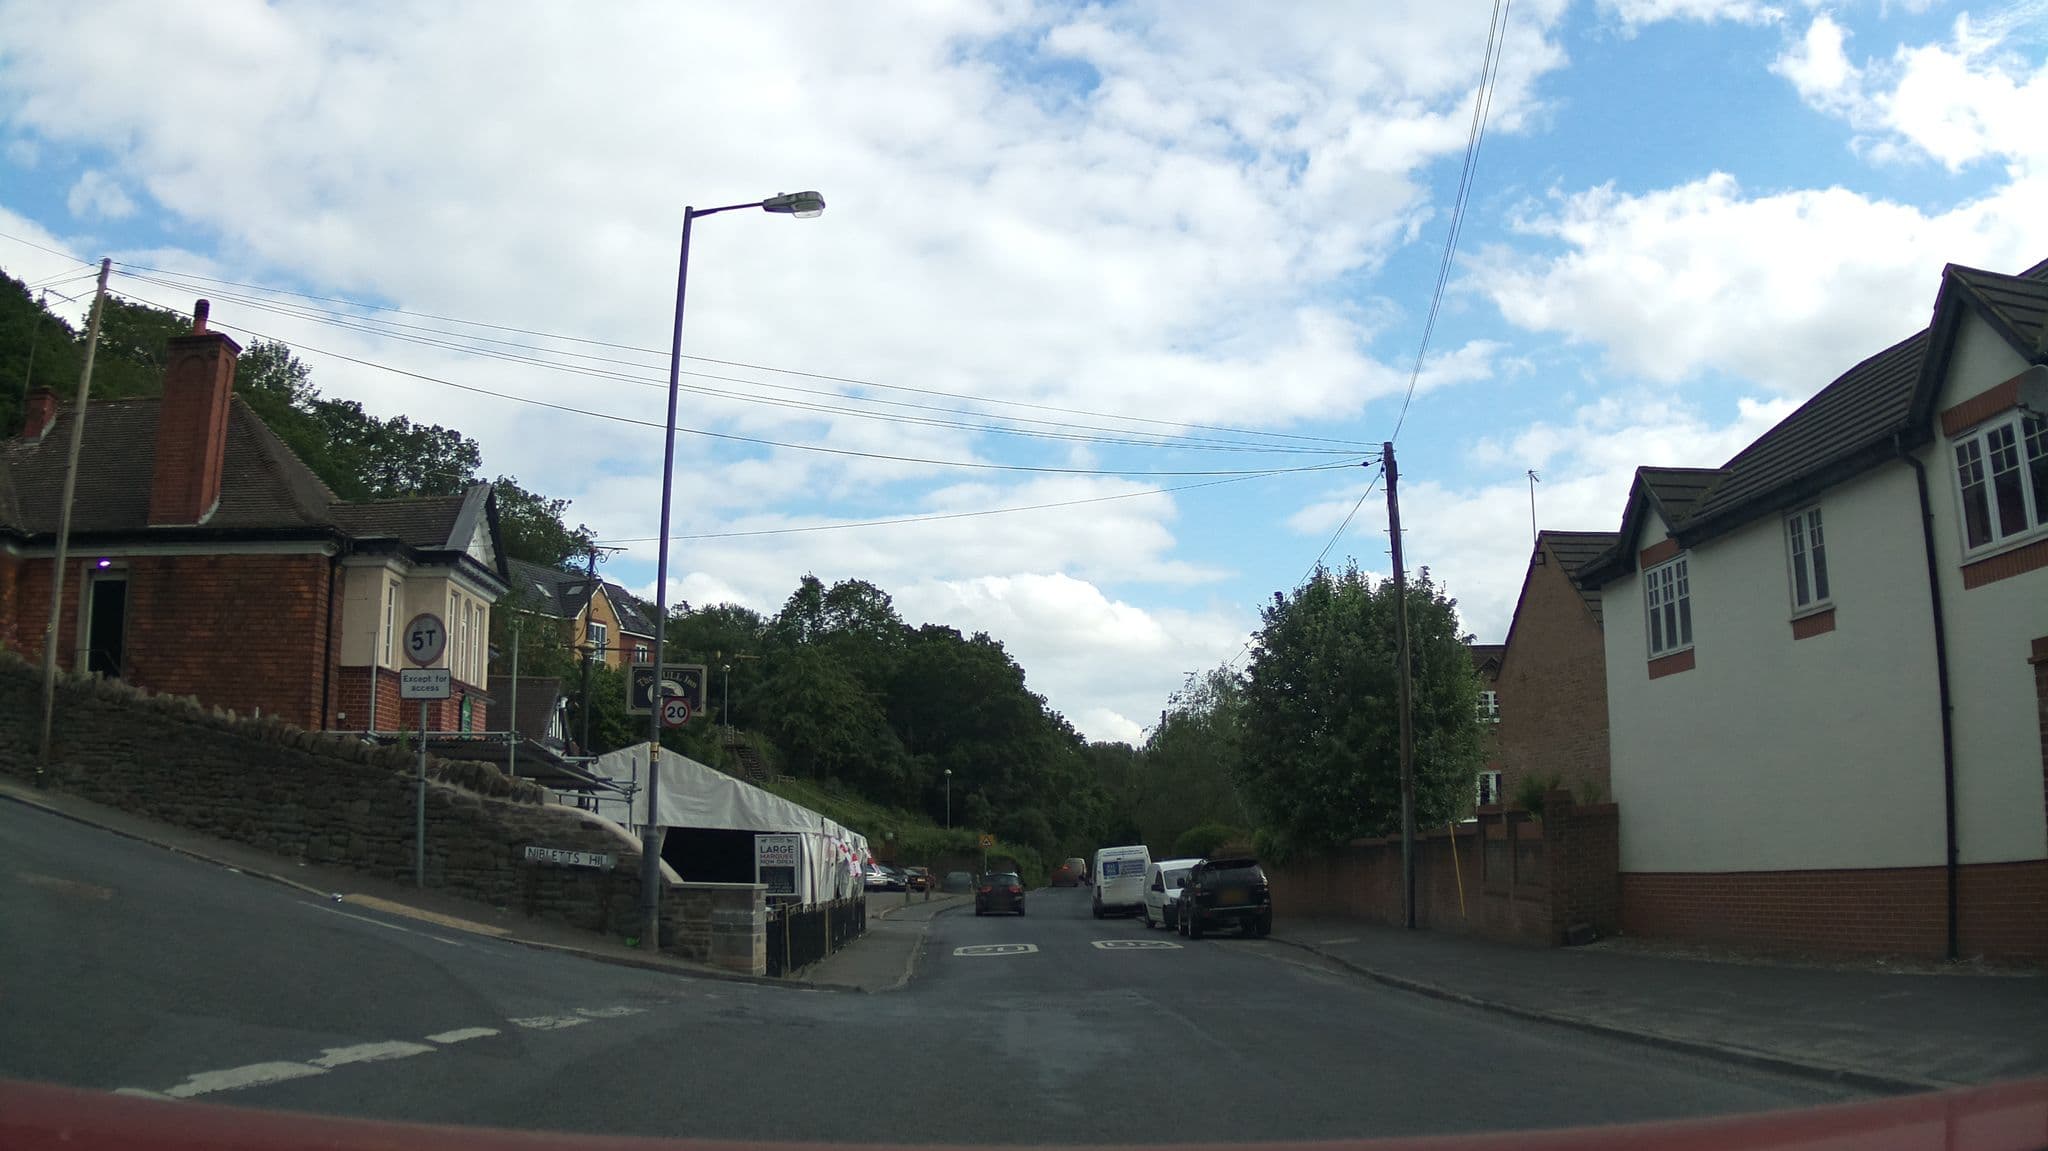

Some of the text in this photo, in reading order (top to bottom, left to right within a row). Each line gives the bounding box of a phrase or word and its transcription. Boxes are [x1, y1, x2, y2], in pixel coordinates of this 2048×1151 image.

[411, 630, 436, 651] 5T
[403, 675, 431, 683] Except
[667, 706, 686, 718] 20
[760, 845, 794, 853] LARGE
